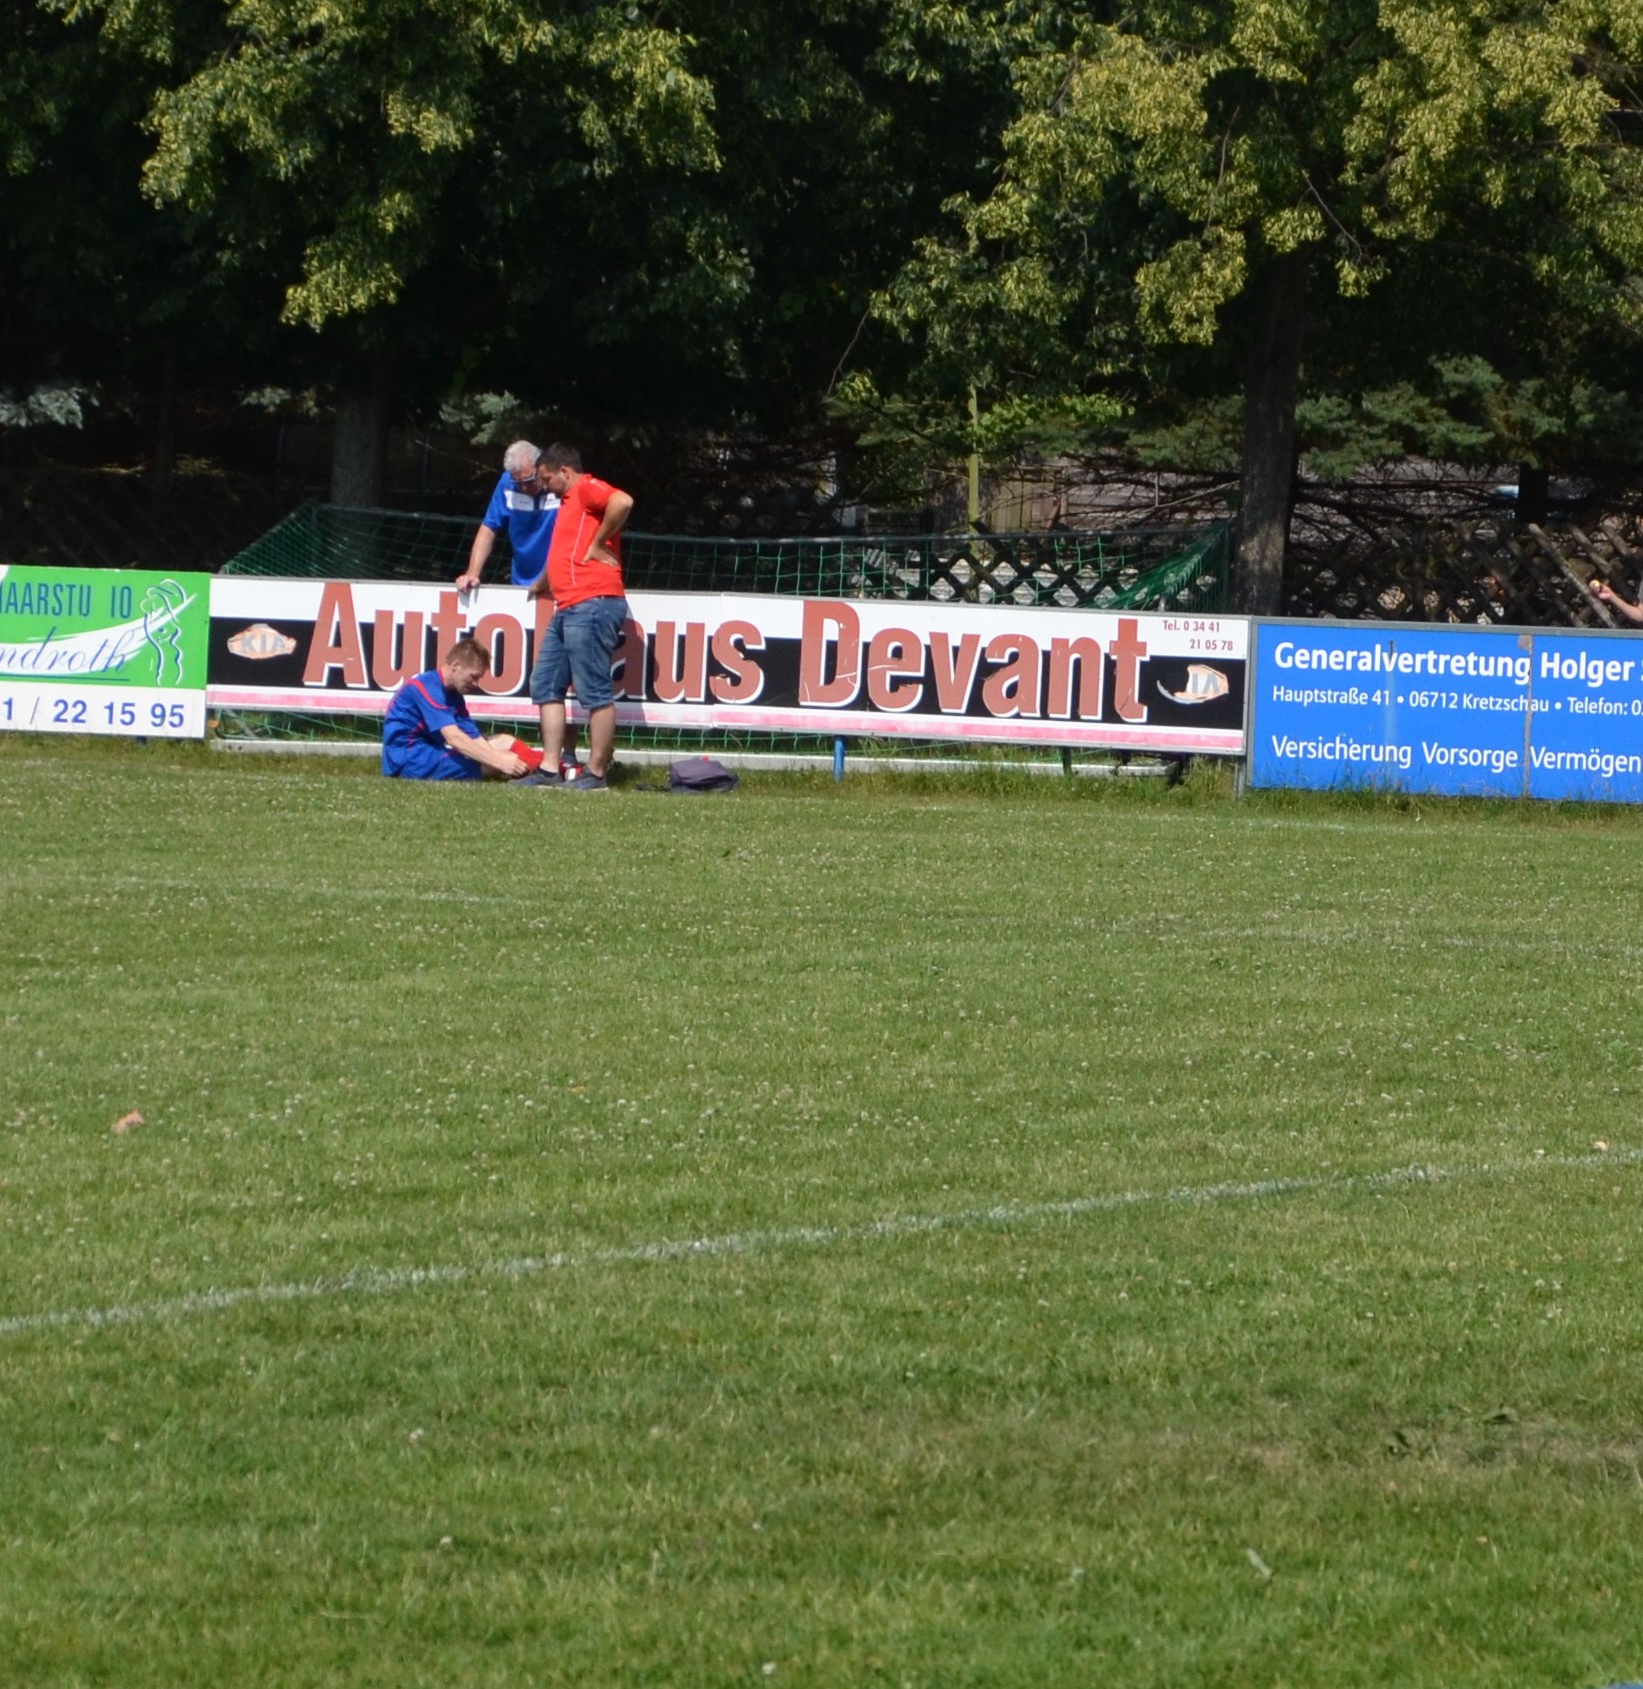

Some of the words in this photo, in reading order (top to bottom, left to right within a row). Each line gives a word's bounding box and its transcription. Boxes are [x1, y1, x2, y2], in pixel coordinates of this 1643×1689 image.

[1163, 619, 1180, 631] Tel.
[1183, 620, 1190, 631] 0
[1193, 621, 1205, 632] 34
[1208, 622, 1220, 632] 41
[1190, 638, 1201, 650] 21
[1205, 639, 1218, 650] 05
[1221, 640, 1234, 651] 78
[798, 600, 1152, 723] Devant
[1275, 642, 1531, 685] Generalvertretung
[1541, 651, 1635, 688] Holger
[53, 699, 88, 724] 22
[104, 702, 135, 726] 15
[150, 704, 185, 728] 95
[1272, 685, 1368, 707] Hauptstraße
[1372, 690, 1391, 705] 41
[1409, 691, 1458, 709] 06712
[1463, 694, 1549, 712] Kretzschau
[1567, 696, 1628, 716] Telefon:
[1272, 735, 1412, 769] Versicherung
[1422, 741, 1518, 773] Vorsorge
[1530, 745, 1642, 777] Vermögen
